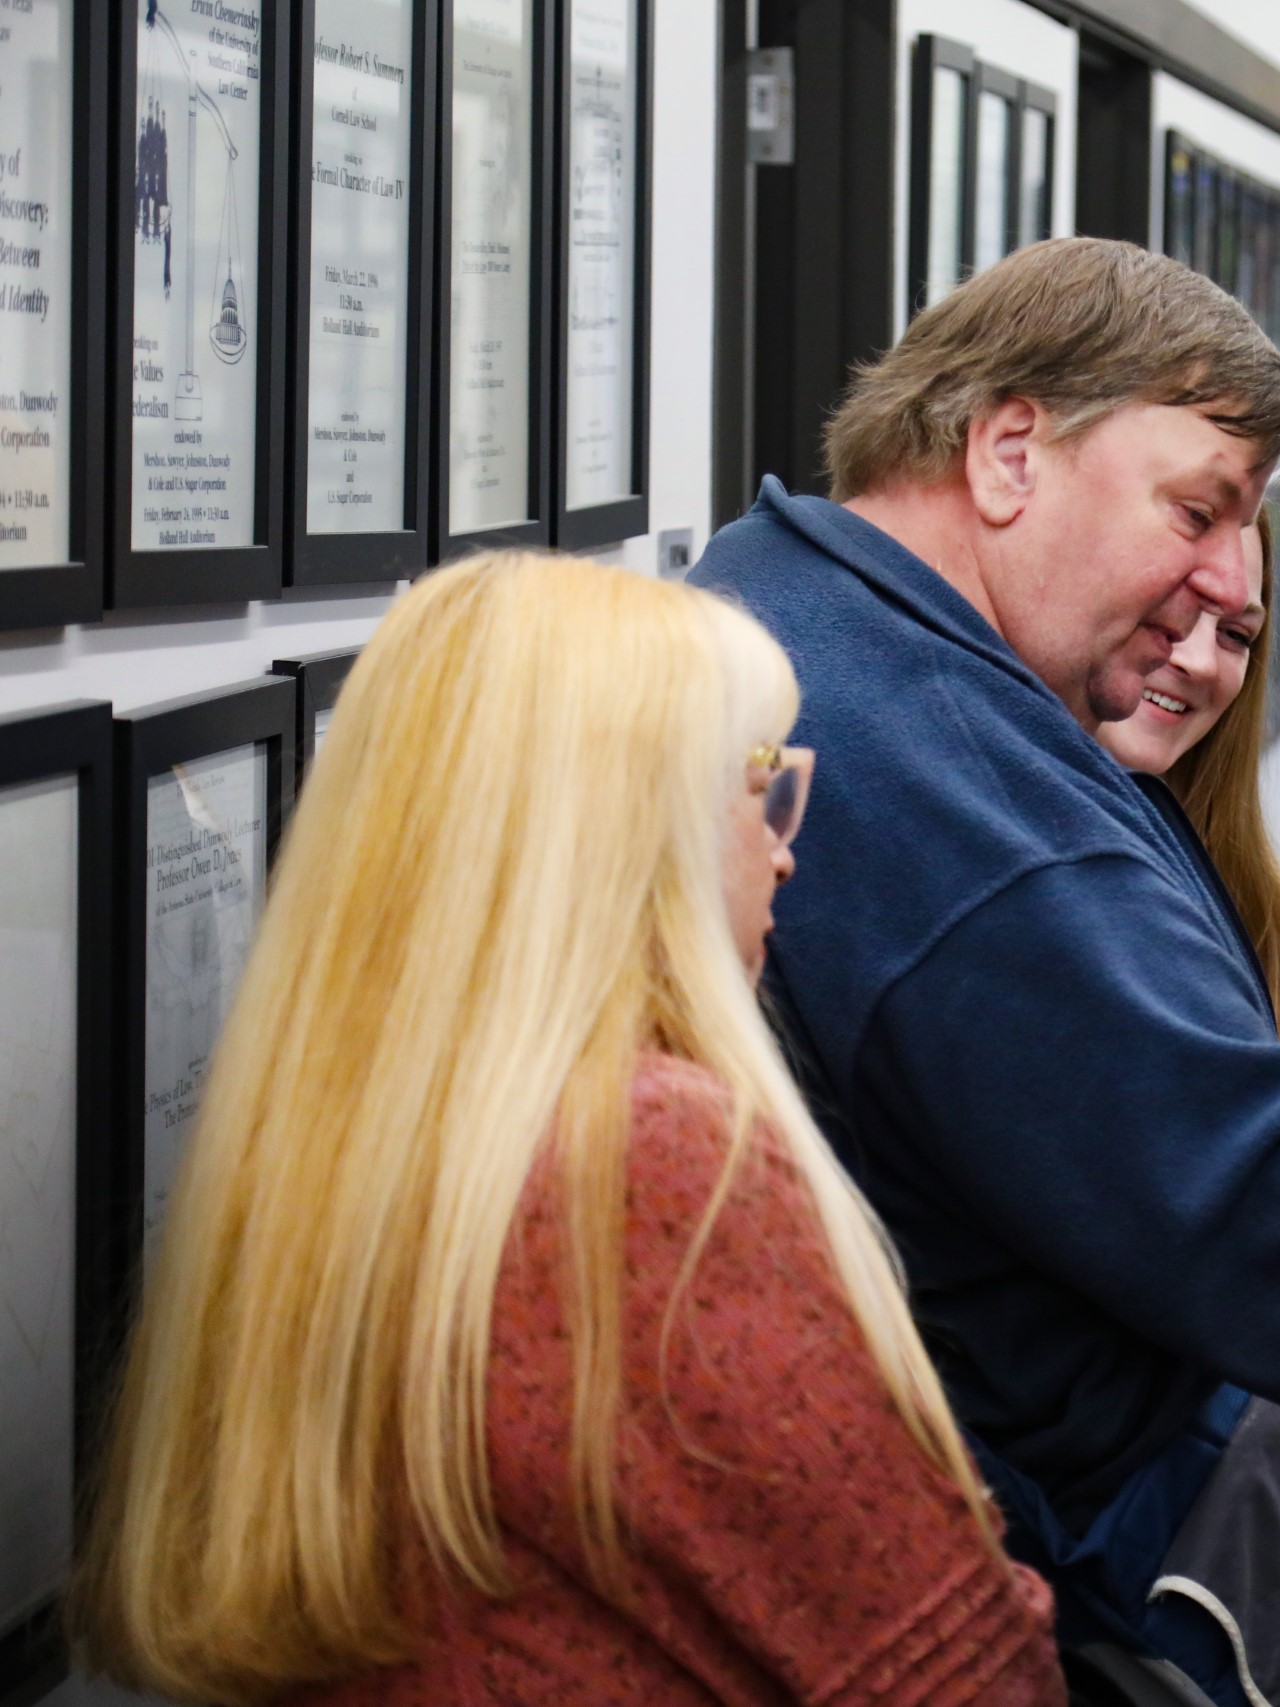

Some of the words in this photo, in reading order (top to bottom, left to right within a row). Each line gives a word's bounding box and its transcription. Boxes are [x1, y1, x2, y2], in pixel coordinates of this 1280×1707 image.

[215, 0, 260, 37] Chemerinsky
[340, 43, 364, 72] Robert
[373, 54, 405, 85] Summers
[316, 161, 339, 187] Formal
[340, 167, 371, 194] Character
[372, 176, 380, 195] of
[380, 177, 395, 197] Law
[0, 190, 49, 232] iscovery:
[8, 284, 50, 323] Identity
[140, 359, 164, 382] Values
[1, 425, 51, 455] Corporation
[157, 830, 202, 866] Distinguished
[157, 864, 190, 892] Professor
[190, 856, 211, 879] Owen
[222, 846, 242, 872] Jones
